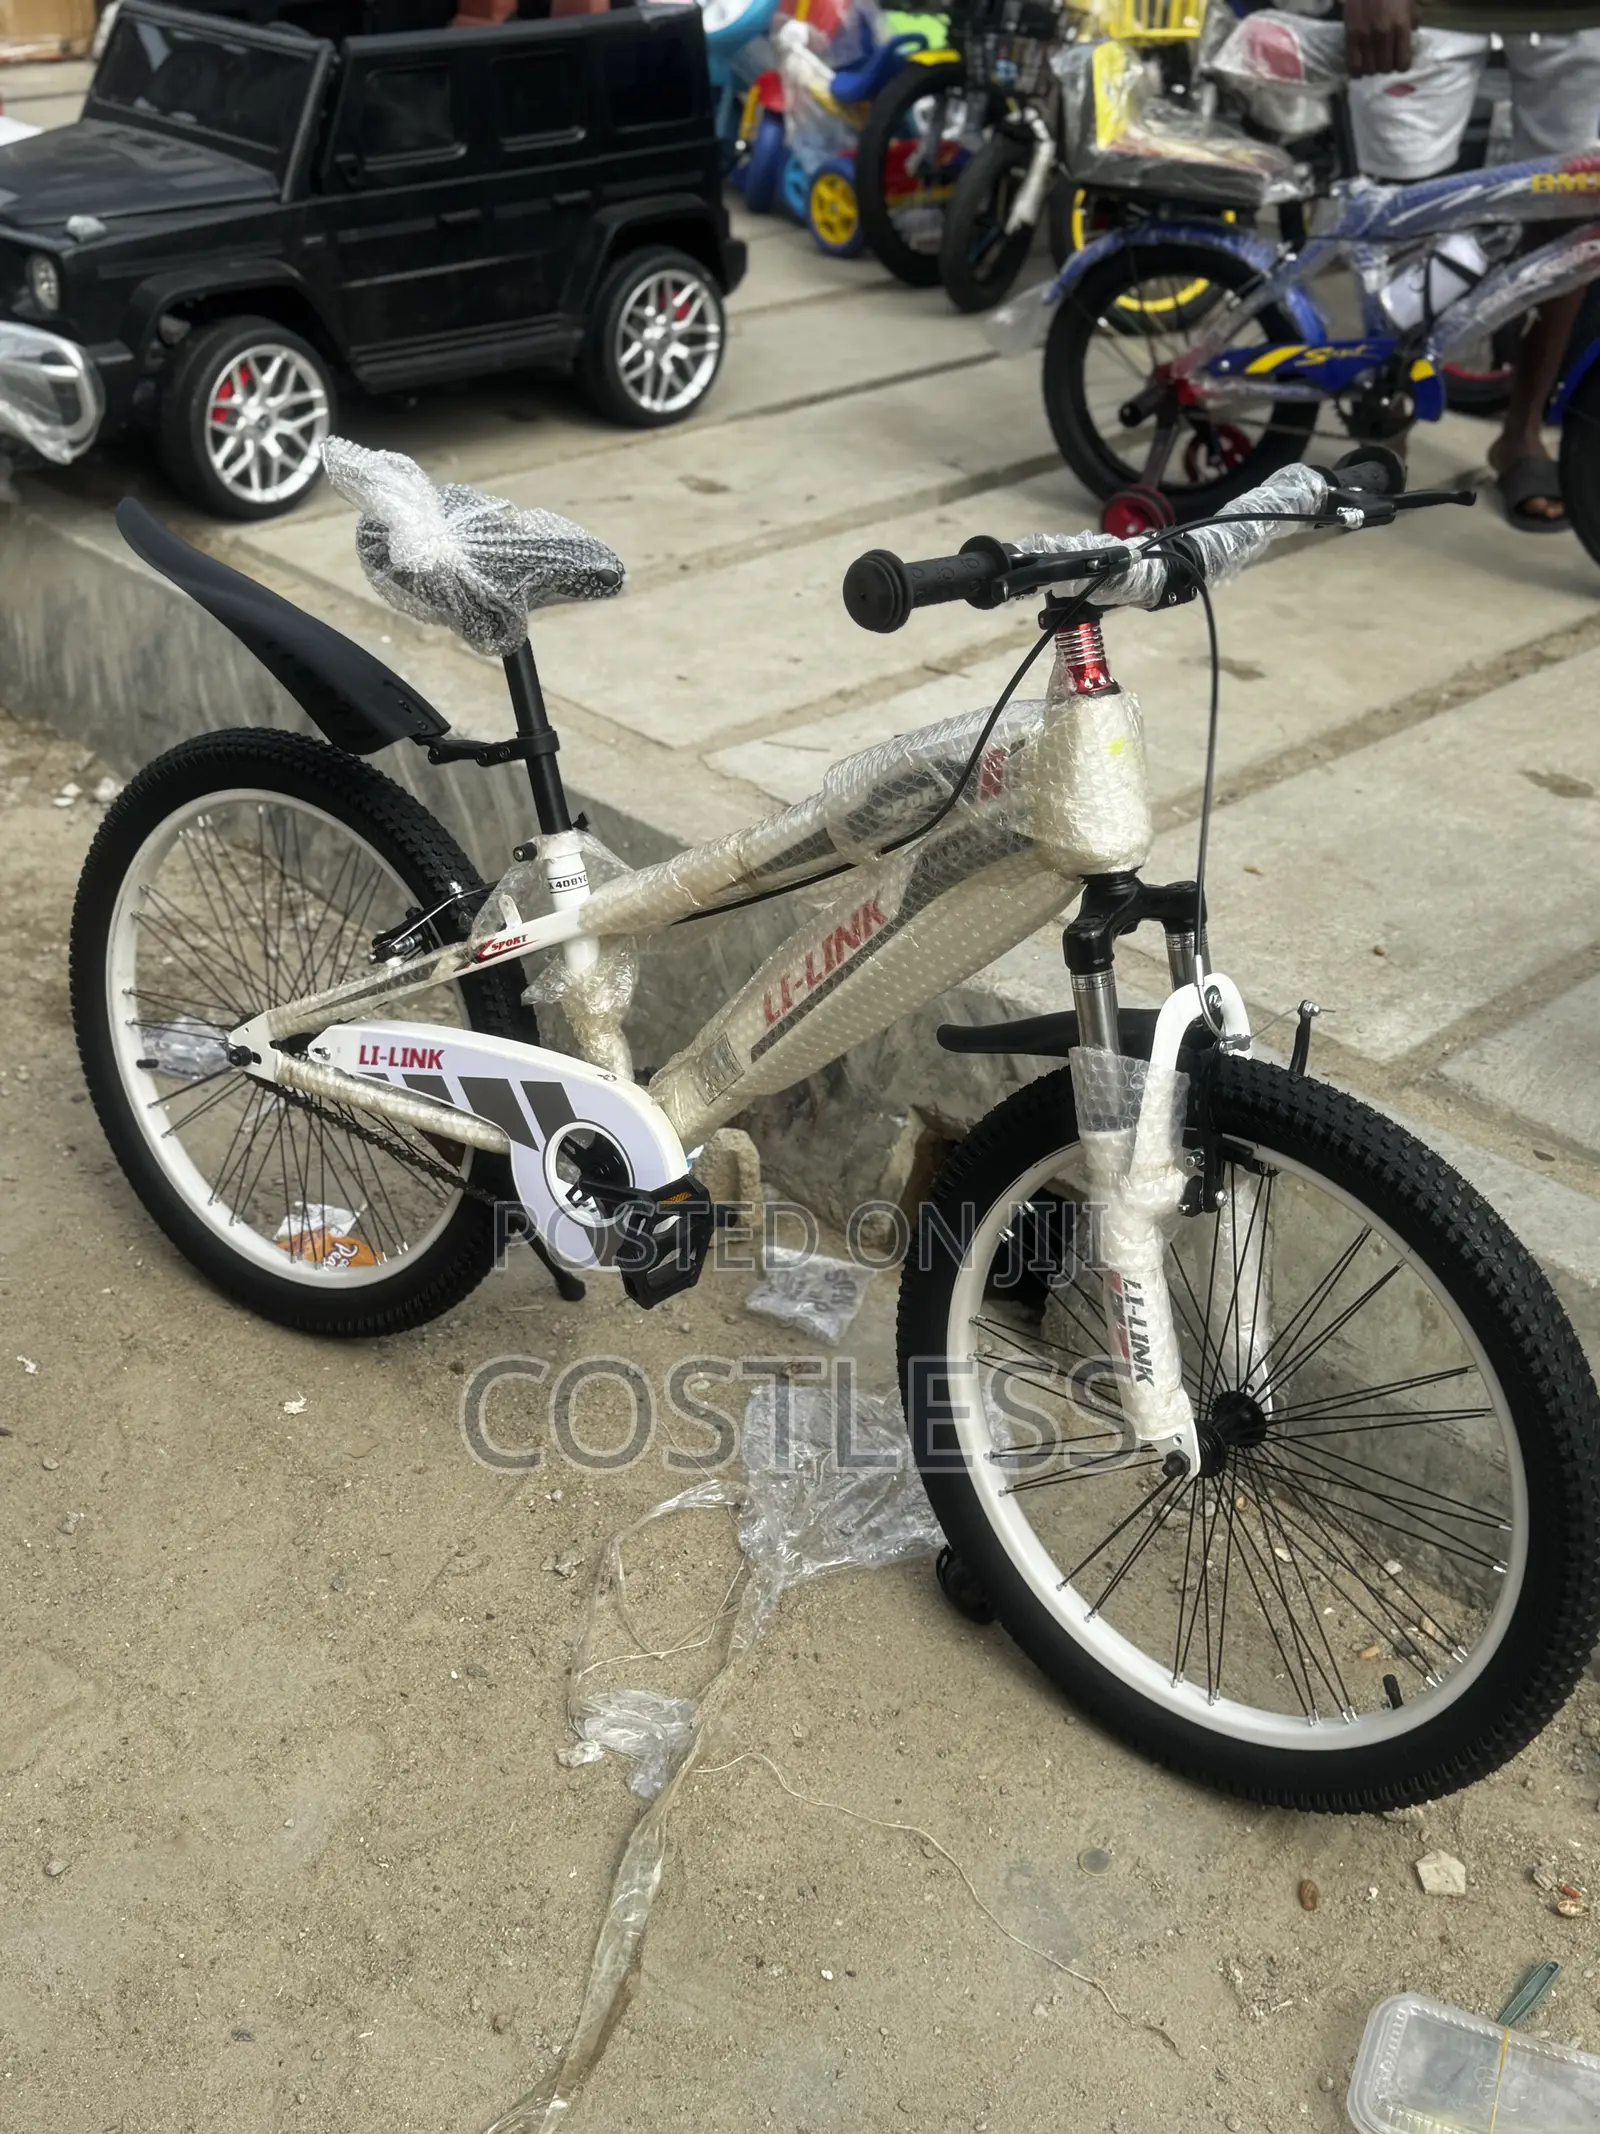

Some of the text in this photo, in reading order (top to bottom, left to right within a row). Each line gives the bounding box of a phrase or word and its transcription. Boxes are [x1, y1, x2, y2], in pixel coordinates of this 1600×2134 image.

[491, 934, 528, 951] SPORT
[763, 887, 889, 1027] LI-LINK
[358, 1044, 446, 1070] LI-LINK
[1122, 1278, 1155, 1388] LI-LINK
